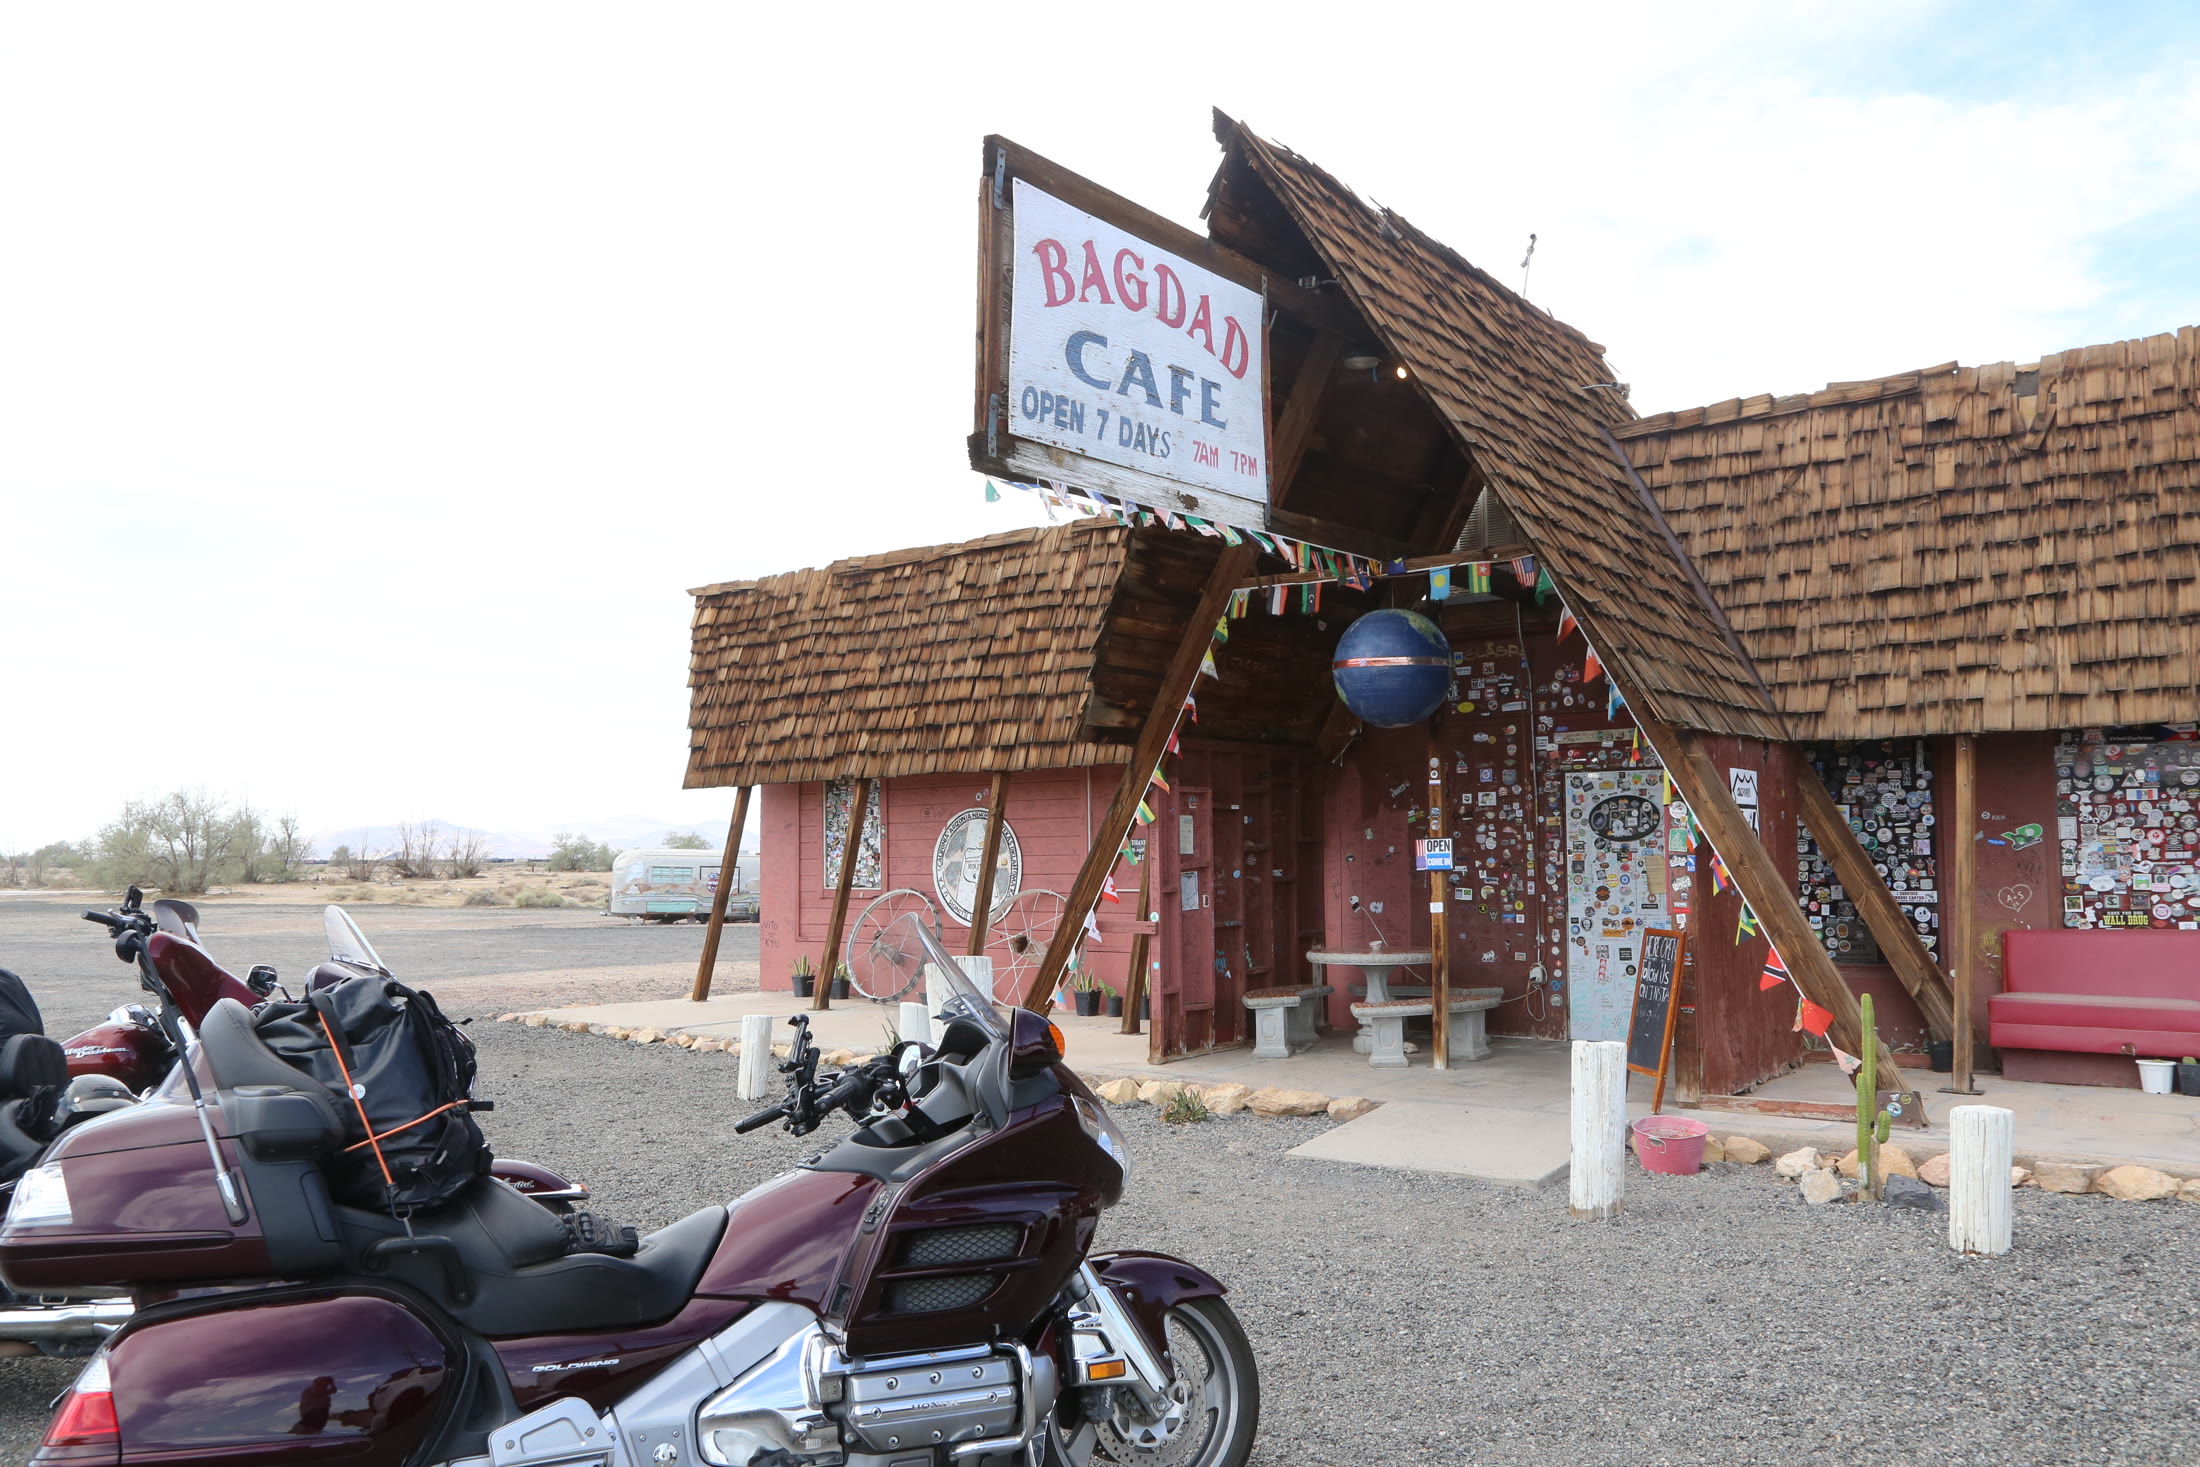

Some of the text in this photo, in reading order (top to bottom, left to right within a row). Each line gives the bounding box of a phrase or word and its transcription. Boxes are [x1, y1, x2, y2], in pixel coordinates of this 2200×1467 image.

[1032, 238, 1249, 380] BAGDAD
[1065, 330, 1228, 430] CAFE
[1021, 385, 1171, 458] OPEN 7 DAYS
[1192, 440, 1258, 478] 7AM 7PM
[1427, 840, 1450, 852] OPEN
[1428, 857, 1451, 866] COME IN
[2103, 915, 2148, 925] WALL DRUG
[532, 1359, 620, 1373] GOLDWING
